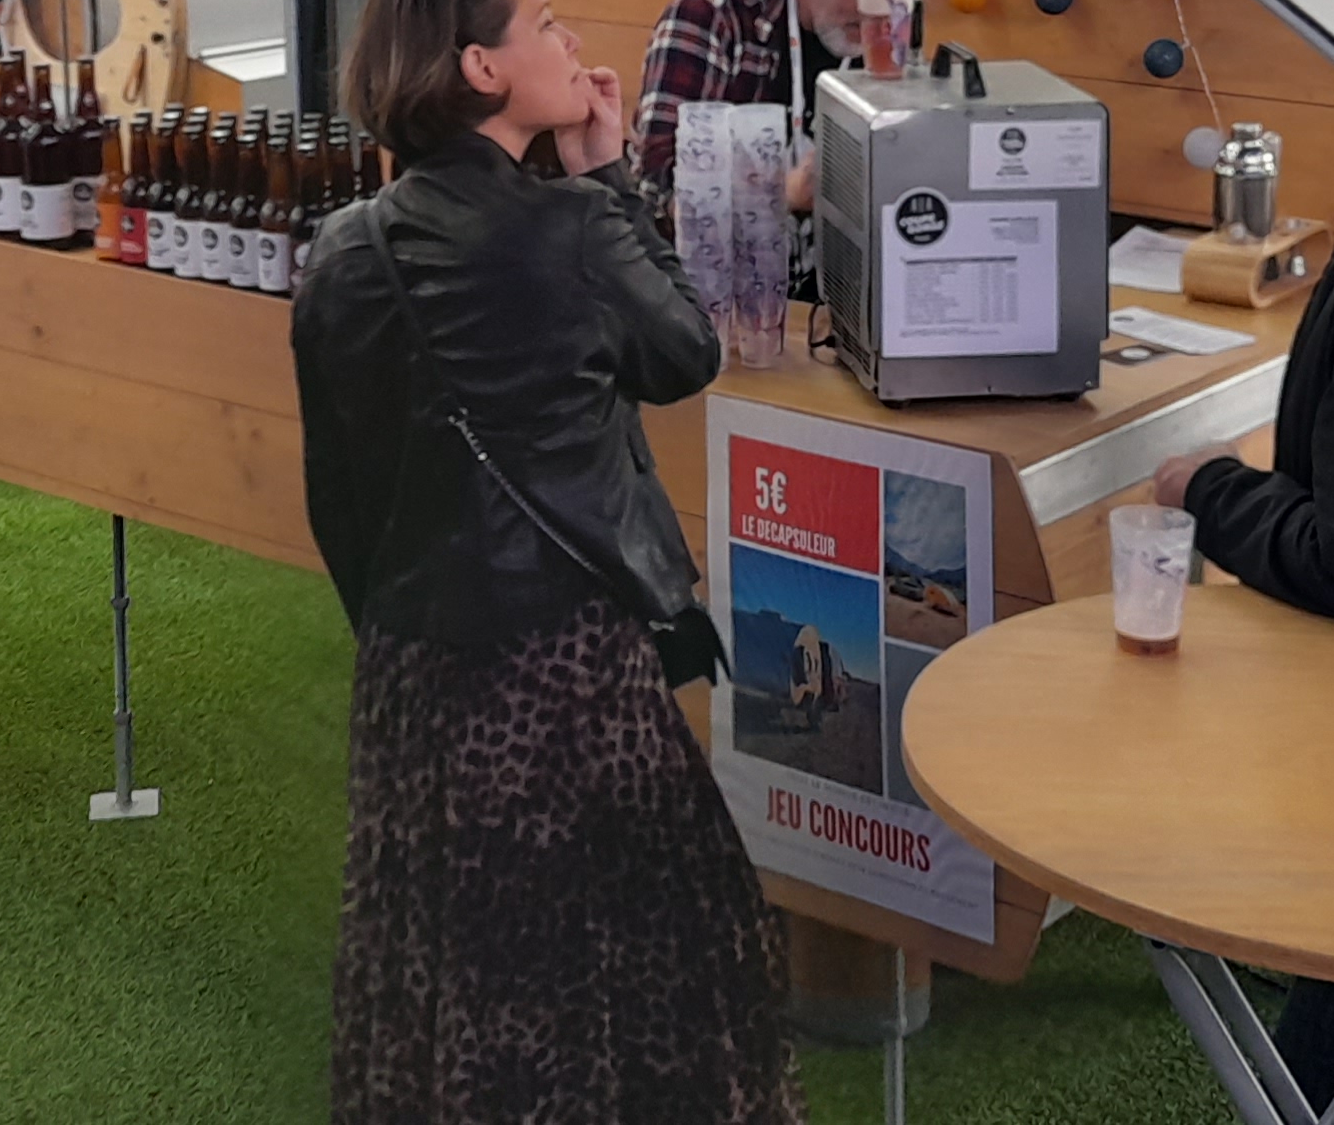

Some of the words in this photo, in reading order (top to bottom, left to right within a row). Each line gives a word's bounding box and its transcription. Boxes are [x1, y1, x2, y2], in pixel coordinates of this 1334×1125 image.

[754, 466, 787, 515] 5€
[742, 513, 755, 536] LE
[757, 517, 836, 558] DECAPSULEUR
[767, 785, 802, 831] JEU
[809, 799, 931, 873] CONCOURS
